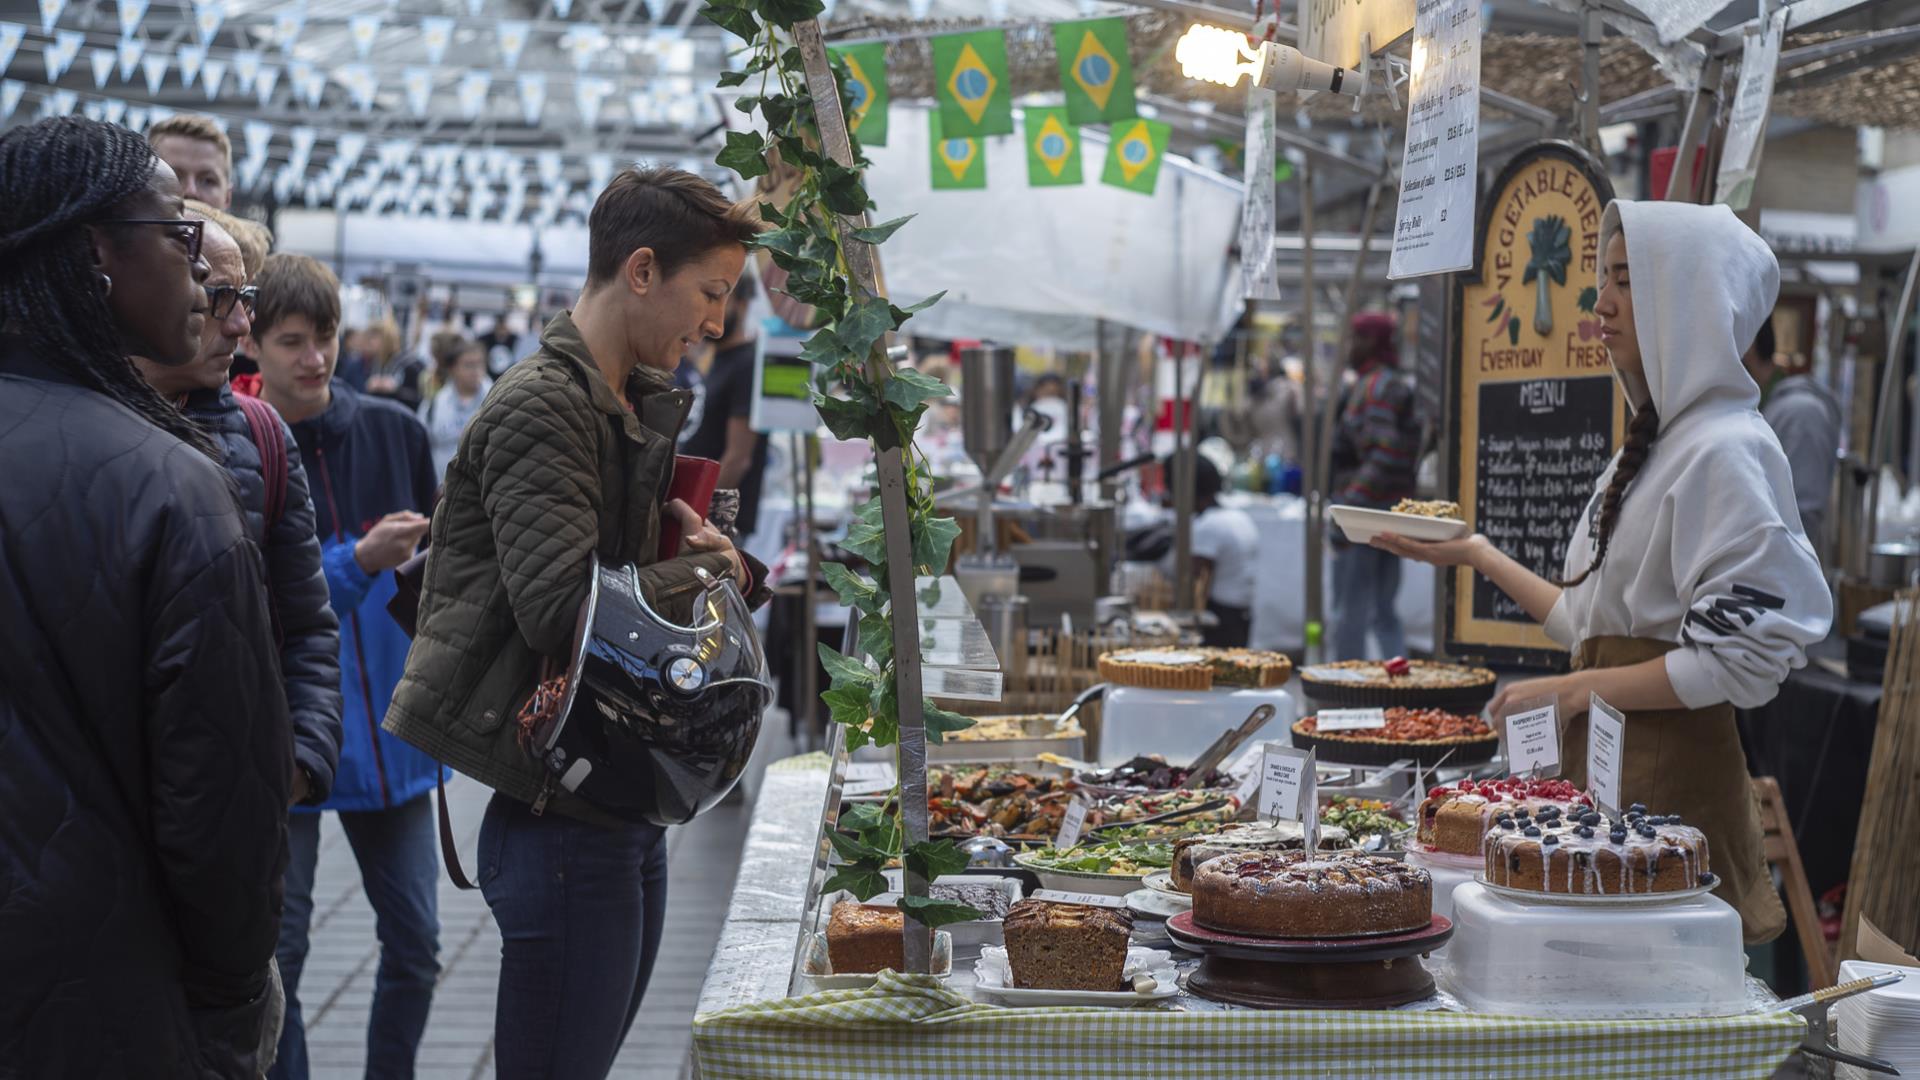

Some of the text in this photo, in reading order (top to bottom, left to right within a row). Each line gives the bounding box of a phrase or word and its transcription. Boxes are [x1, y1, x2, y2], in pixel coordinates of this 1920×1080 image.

[1494, 167, 1599, 292] VEGETABLE HERE
[1480, 338, 1545, 372] EVERYDAY
[1519, 381, 1567, 407] MENU
